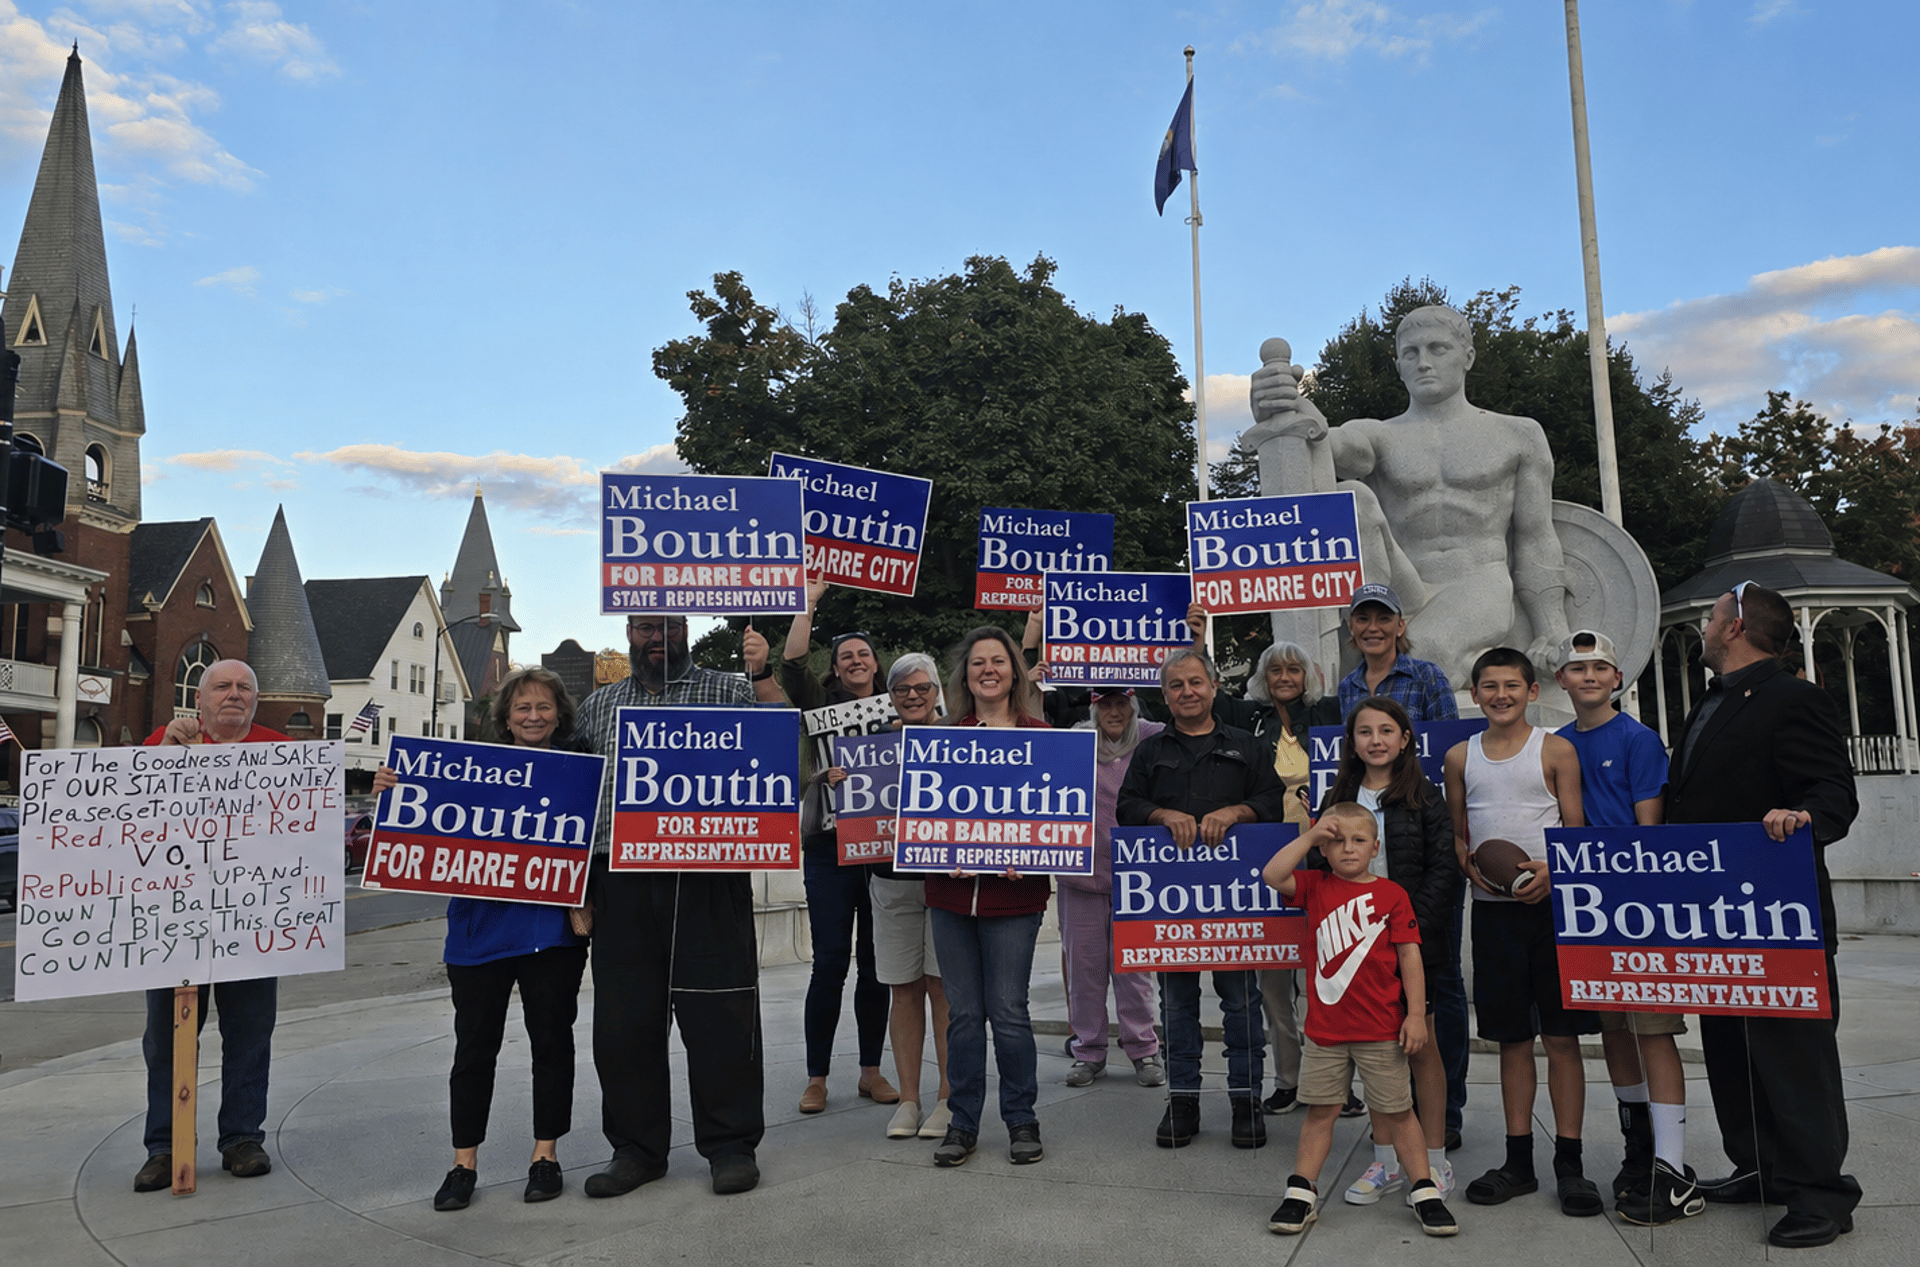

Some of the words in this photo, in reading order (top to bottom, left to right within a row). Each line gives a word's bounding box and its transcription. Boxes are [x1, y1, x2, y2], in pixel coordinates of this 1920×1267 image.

[607, 485, 739, 511] Michael
[804, 510, 917, 550] outin
[981, 514, 1071, 537] Michael
[1192, 504, 1302, 532] Michael
[606, 516, 800, 559] Boutin
[1194, 528, 1356, 570] Boutin
[979, 537, 1108, 571] Boutin
[610, 566, 656, 586] FOR
[663, 566, 741, 586] BARRE
[749, 567, 799, 586] CITY
[869, 555, 914, 586] CITY
[1005, 577, 1033, 589] FOR
[612, 591, 657, 606] STATE
[666, 591, 797, 606] REPRESENTATIVE
[1048, 581, 1148, 602] Michael
[1196, 579, 1234, 606] FOR
[1239, 574, 1306, 603] BARRE
[1312, 570, 1357, 599] CITY
[1048, 606, 1193, 642] Boutin
[1051, 646, 1085, 662] FOR
[1090, 647, 1148, 663] BARRE
[1051, 666, 1084, 679] STATE
[623, 721, 743, 750] Michael
[25, 753, 65, 776] For
[70, 752, 118, 773] The
[906, 739, 1033, 765] Michael
[394, 748, 533, 788] Michael
[619, 757, 795, 806] Boutin
[23, 779, 56, 800] OF
[66, 776, 118, 797] OUR
[903, 770, 1090, 816] Boutin
[183, 815, 255, 840] VOTE
[270, 810, 317, 835] Red
[379, 783, 586, 845] Boutin
[656, 816, 695, 835] FOR
[700, 817, 759, 835] STATE
[905, 820, 948, 841] FOR
[955, 821, 1031, 843] BARRE
[1038, 823, 1087, 845] CITY
[619, 843, 791, 861] REPRESENTATIVE
[905, 847, 948, 864] STATE
[956, 849, 1084, 867] REPRESENTATIVE
[1551, 839, 1725, 874] Michael
[372, 841, 425, 880] FOR
[430, 847, 519, 888] BARRE
[525, 856, 585, 893] CITY
[108, 893, 160, 919] The
[1554, 882, 1819, 941] Boutin
[42, 919, 114, 948] God
[133, 917, 209, 940] Bless
[190, 936, 239, 961] The
[255, 925, 325, 953] USA
[1154, 924, 1195, 940] FOR
[1201, 922, 1264, 939] STATE
[1316, 892, 1375, 971] NIKE
[1122, 945, 1299, 965] REPRESENTATIVE
[1611, 952, 1667, 973] FOR
[1675, 953, 1765, 976] STATE
[1569, 980, 1818, 1008] REPRESENTATIVE
